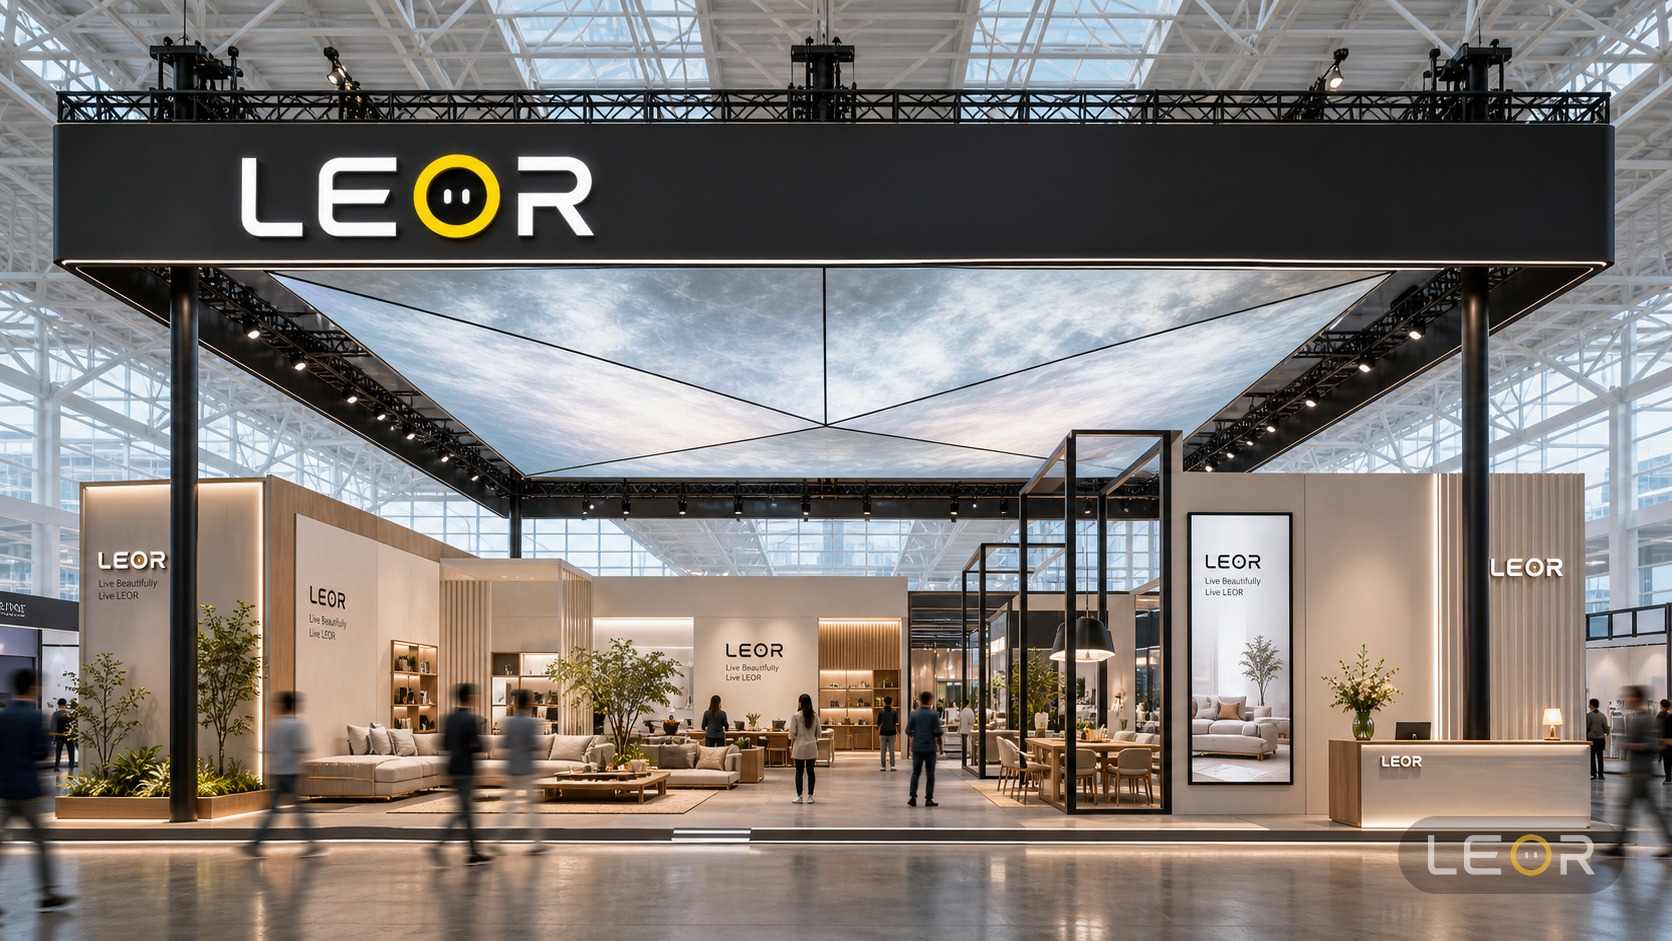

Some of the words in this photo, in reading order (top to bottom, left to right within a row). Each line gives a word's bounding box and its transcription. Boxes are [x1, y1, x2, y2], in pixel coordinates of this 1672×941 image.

[241, 154, 595, 239] LEOR
[98, 551, 167, 570] LEOR
[1205, 554, 1261, 570] LEOR
[1490, 557, 1564, 578] LEOR
[98, 579, 115, 588] Live
[116, 579, 158, 589] Beautifully
[1205, 577, 1221, 585] Live
[1222, 577, 1262, 587] Beautifully
[98, 592, 115, 600] Live
[116, 591, 140, 600] LEOR
[309, 585, 346, 610] LEOR
[1205, 588, 1221, 596] Live
[1222, 588, 1244, 596] LEOR
[321, 630, 336, 640] LEOR
[725, 643, 784, 658] LEOR
[725, 664, 741, 672] Live
[741, 673, 762, 681] LEOR
[1381, 755, 1423, 768] LEOR
